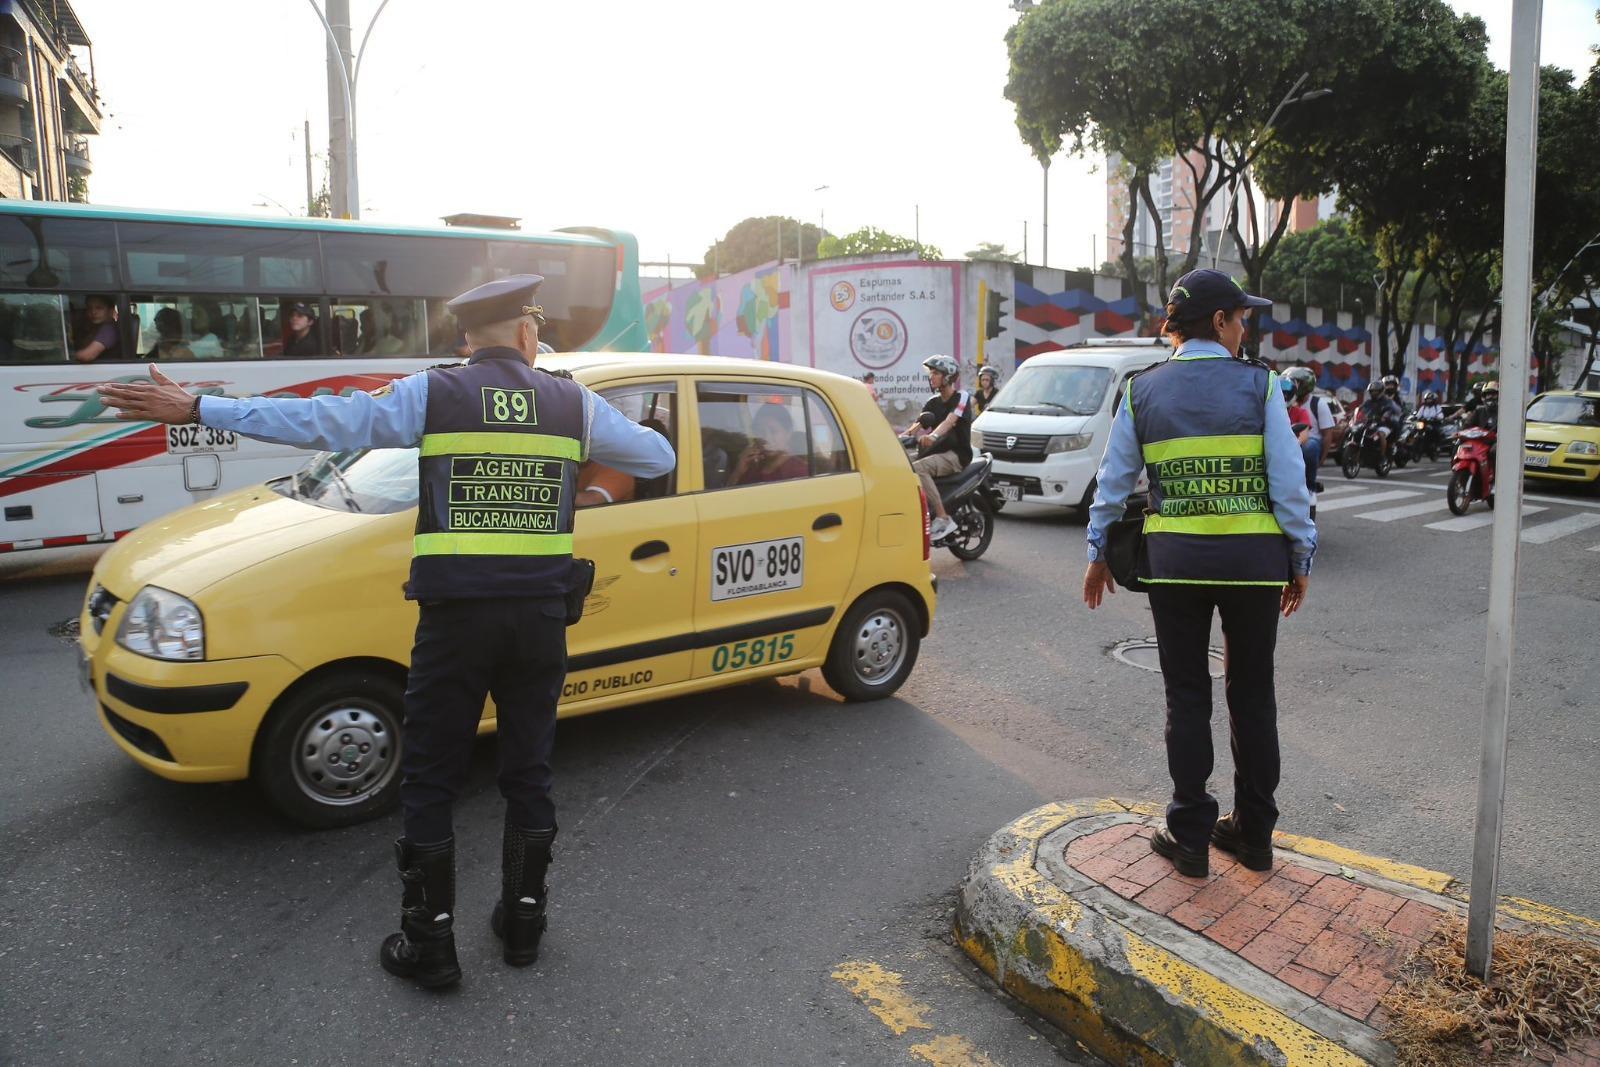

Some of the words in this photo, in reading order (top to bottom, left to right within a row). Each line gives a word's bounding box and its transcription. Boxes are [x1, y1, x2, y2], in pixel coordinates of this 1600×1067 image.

[860, 279, 902, 290] Espumas
[860, 293, 905, 302] Santander
[897, 375, 909, 384] por
[912, 373, 920, 381] el
[492, 390, 529, 422] 89
[169, 426, 199, 447] SOZ
[205, 426, 235, 446] 383
[473, 461, 545, 477] AGENTE
[1160, 458, 1232, 477] AGENTE
[1243, 457, 1263, 472] DE
[462, 485, 551, 501] TRANSITO
[1162, 478, 1265, 495] TRANSITO
[1162, 497, 1266, 514] BUCARAMANGA
[454, 512, 552, 529] BUCARAMANGA
[716, 548, 754, 586] SVO
[767, 542, 801, 578] 898
[727, 580, 788, 595] FLORIDABLANCA
[712, 634, 796, 672] 05815
[563, 682, 588, 698] CIO
[592, 669, 653, 692] PUBLICO
